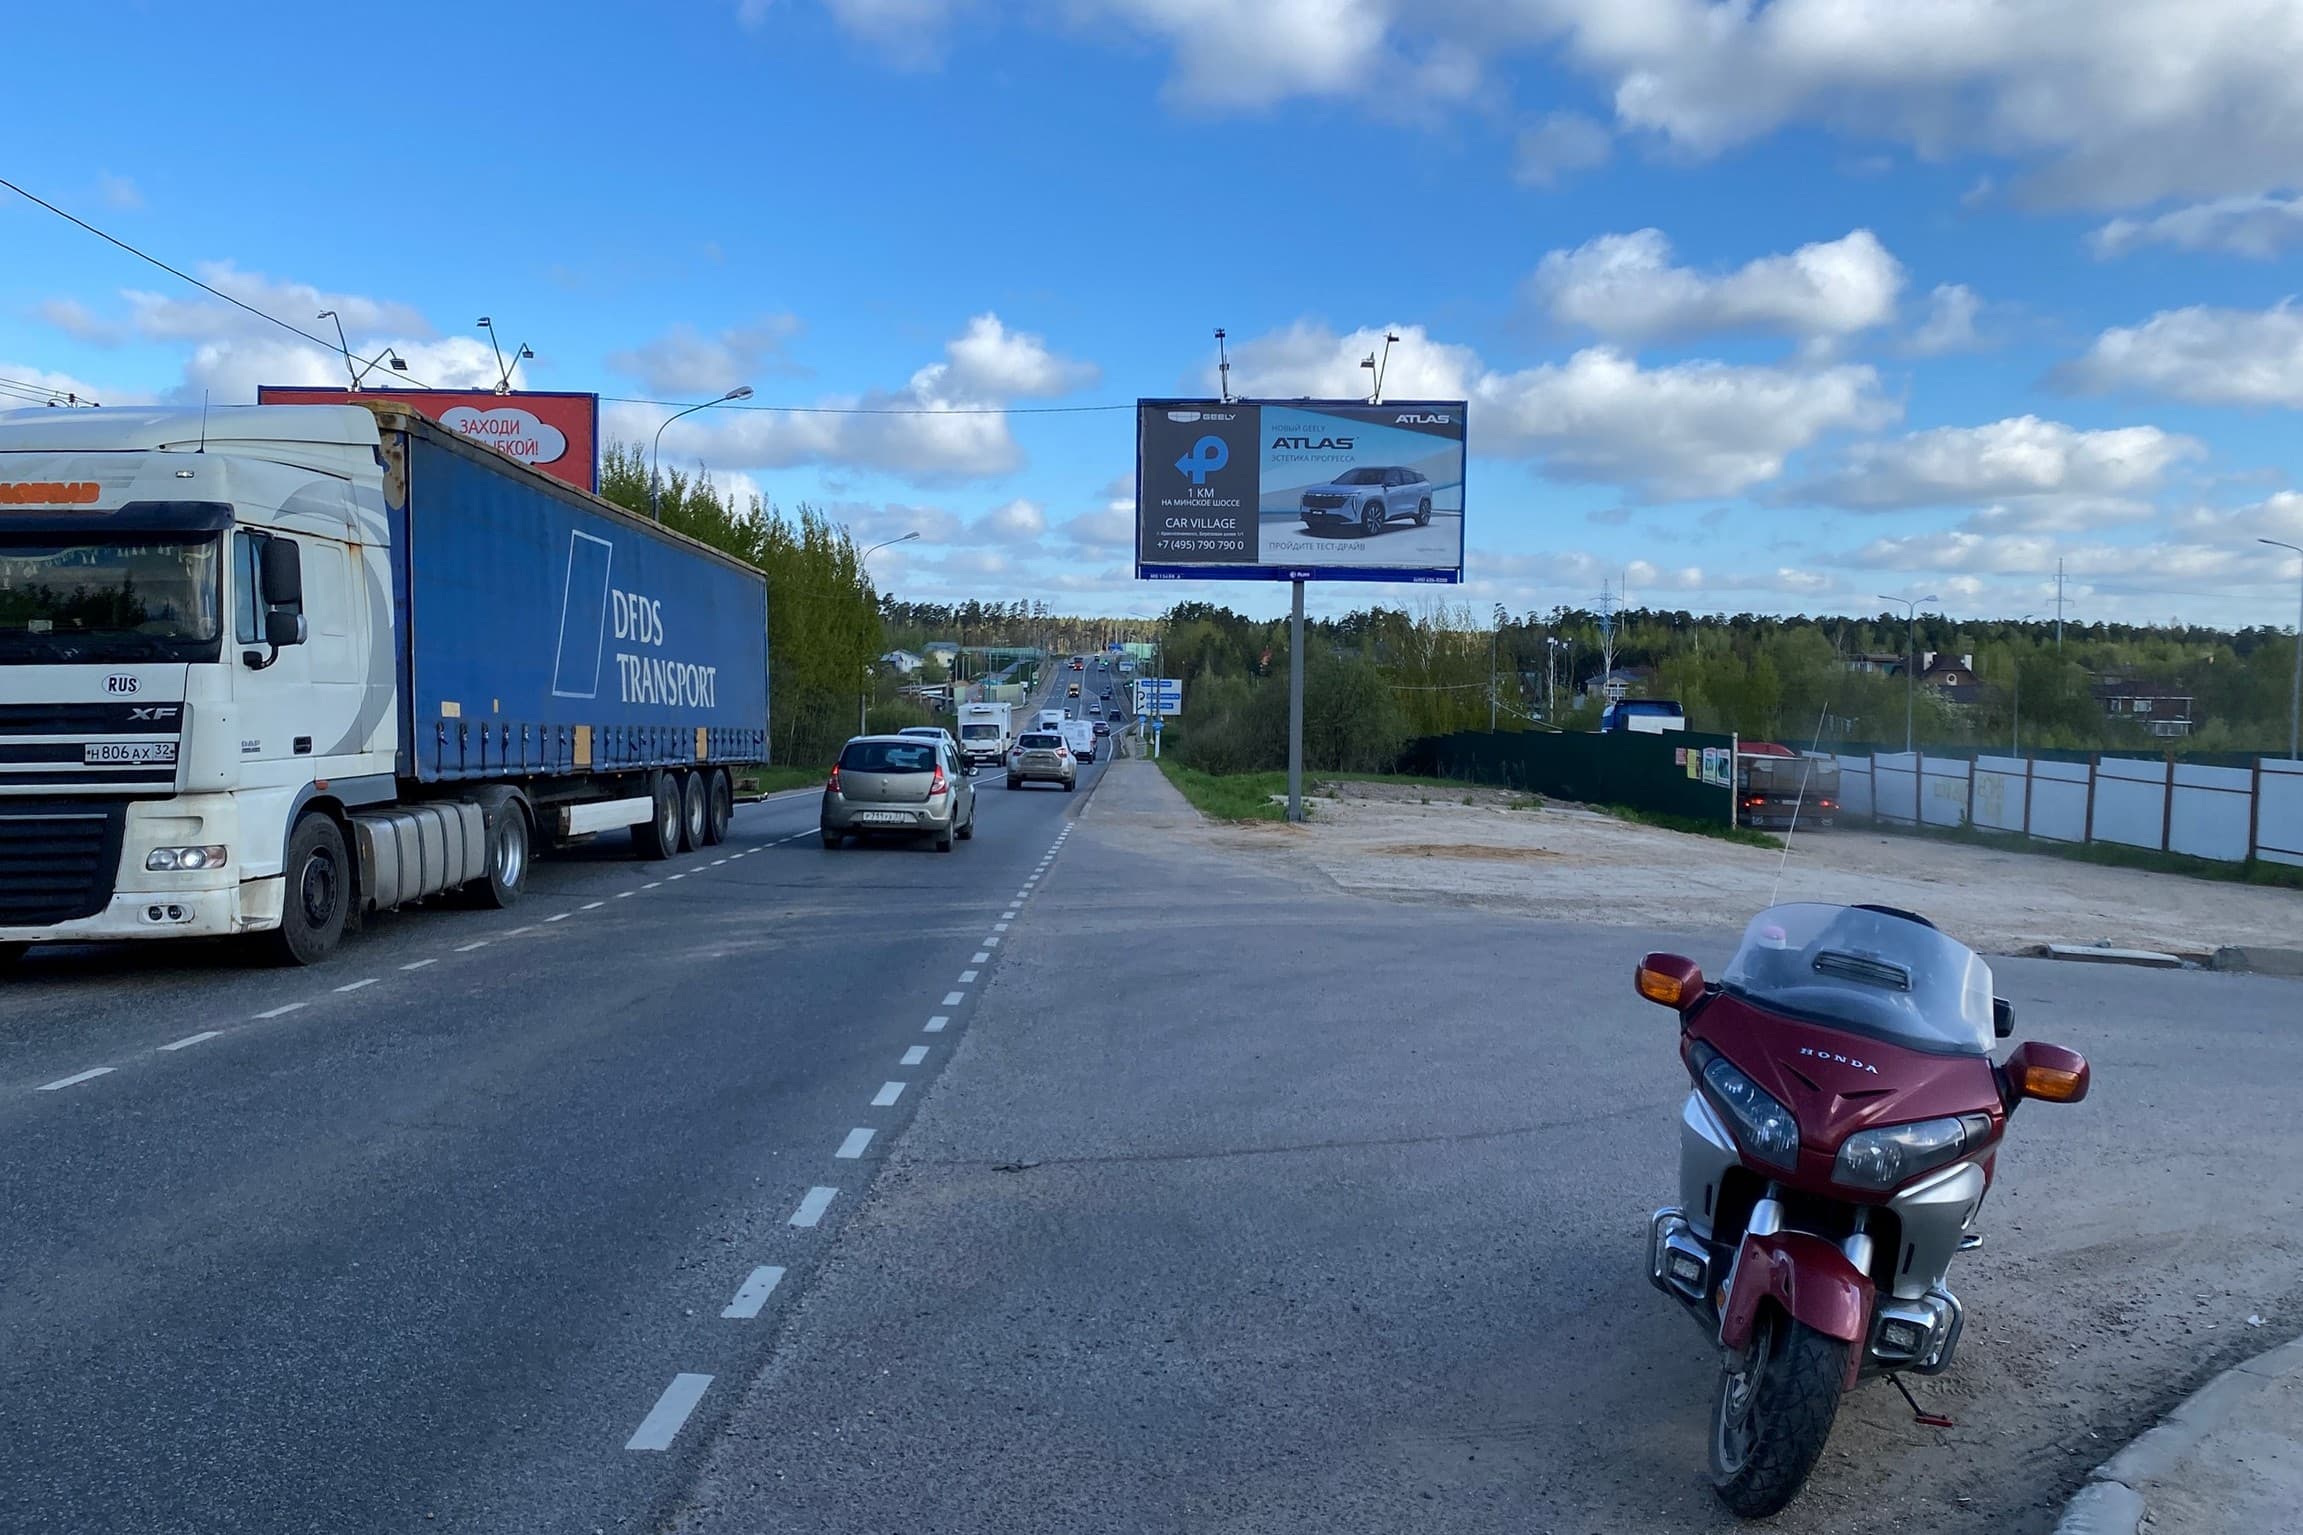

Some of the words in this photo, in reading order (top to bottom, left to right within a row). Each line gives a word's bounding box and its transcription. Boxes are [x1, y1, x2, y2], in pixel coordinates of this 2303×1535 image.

[1203, 413, 1236, 421] GEELY
[1395, 414, 1450, 424] ATLAS
[460, 419, 520, 436] ЗАХОДИ
[1302, 424, 1325, 433] GEELY
[1272, 437, 1355, 450] ATLAS
[1272, 454, 1309, 462] ЭСТЕТИКА
[1311, 454, 1356, 462] ПРОГРЕССА
[1188, 488, 1193, 498] 1
[1161, 499, 1173, 507] НА
[1173, 499, 1212, 507] МИНСКОЕ
[1212, 499, 1241, 507] ШОССЕ
[1165, 518, 1188, 528] CAR
[1190, 518, 1236, 529] VILLAGE
[1157, 540, 1169, 549] +7
[1170, 540, 1195, 551] (495)
[1197, 541, 1216, 550] 790
[1217, 541, 1236, 550] 790
[1237, 541, 1244, 550] 0
[1269, 542, 1313, 551] ПРОЙДИТЕ
[1315, 543, 1366, 552] ТЕСТ-ДРАЙВ
[612, 589, 664, 647] DFDS
[108, 677, 137, 692] RUS
[616, 653, 717, 708] TRANSPORT
[127, 707, 178, 720] XF
[1800, 1047, 1879, 1075] HONDA
